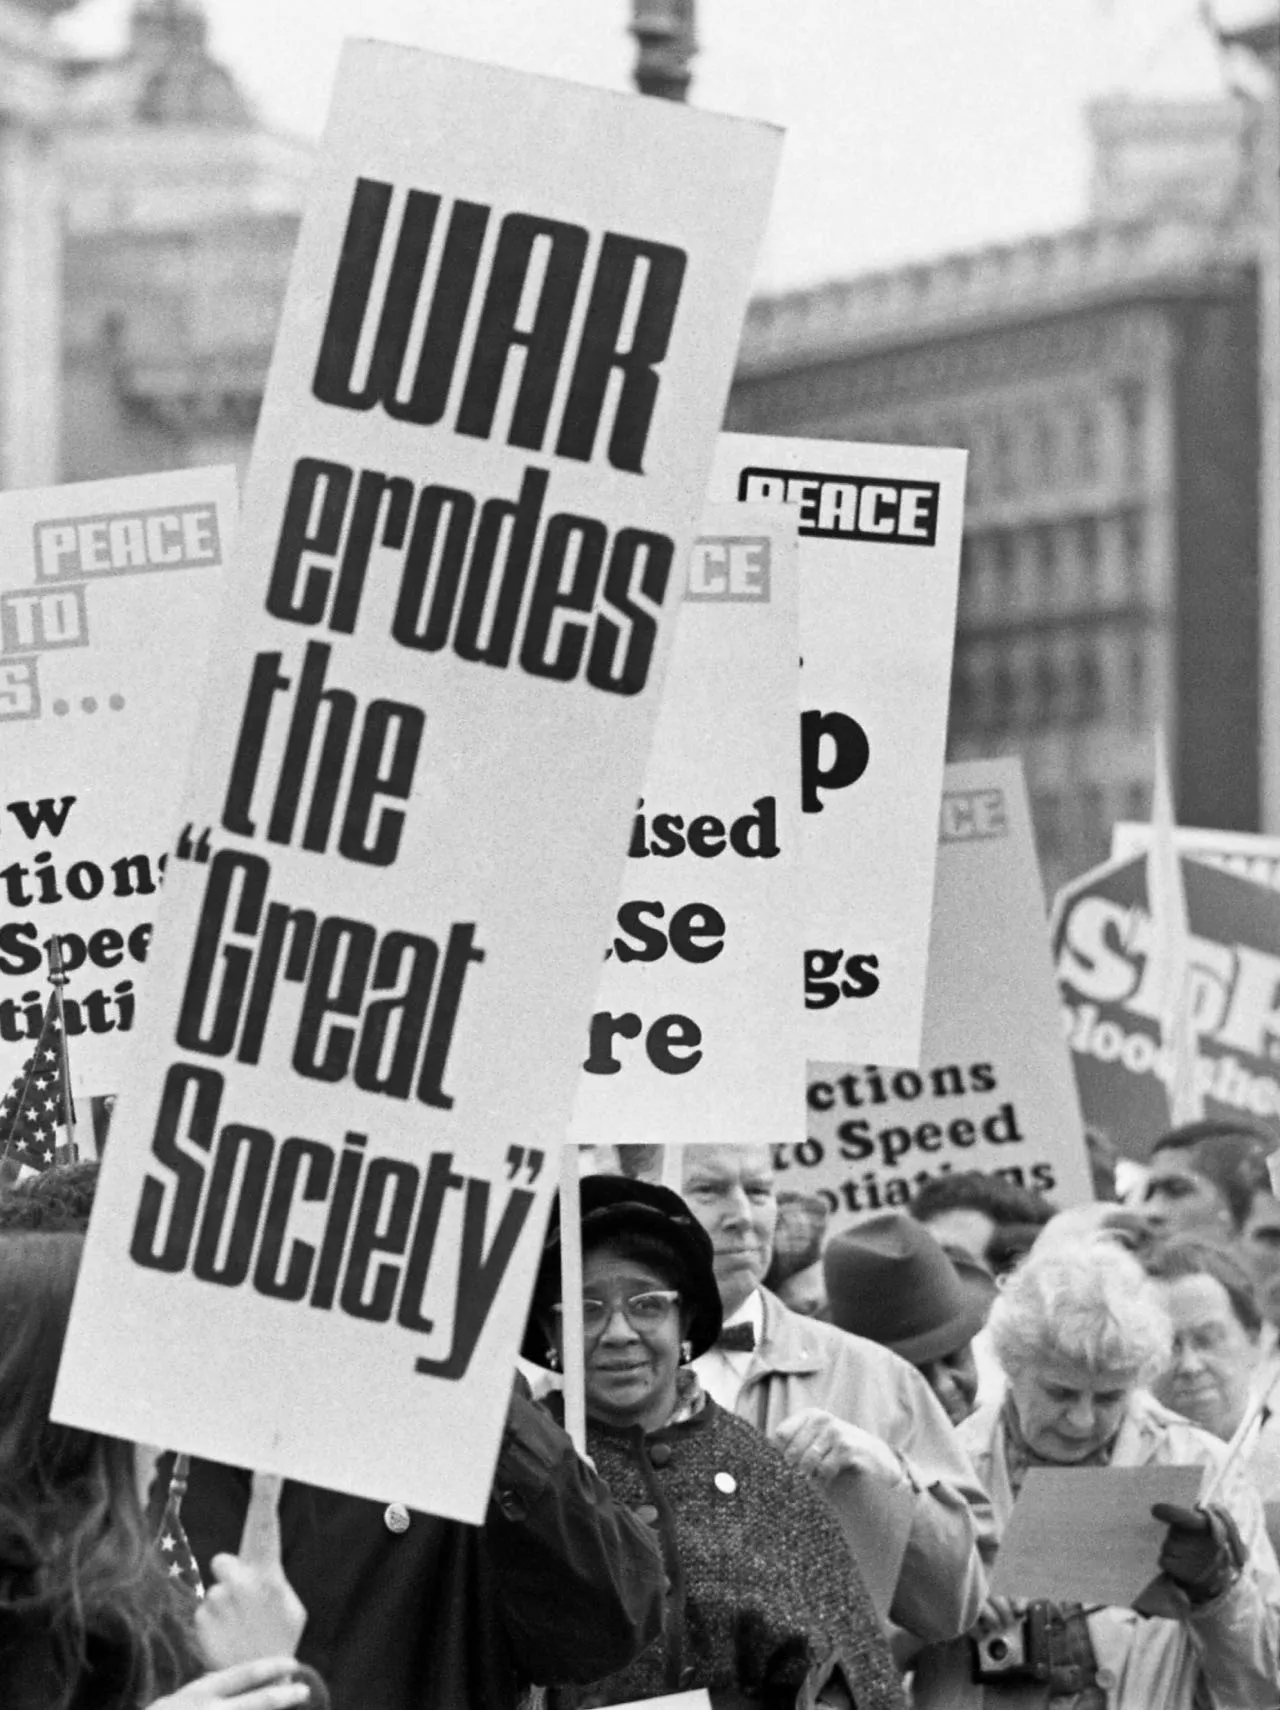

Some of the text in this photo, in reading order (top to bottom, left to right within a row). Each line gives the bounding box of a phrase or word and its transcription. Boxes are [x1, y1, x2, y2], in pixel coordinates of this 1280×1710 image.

[311, 176, 688, 476] WAR
[39, 511, 215, 576] PEACE
[265, 456, 675, 696] erodes
[7, 592, 82, 645] TO
[220, 640, 426, 868] the
[604, 900, 726, 964] se
[837, 1102, 1024, 1167] Speed
